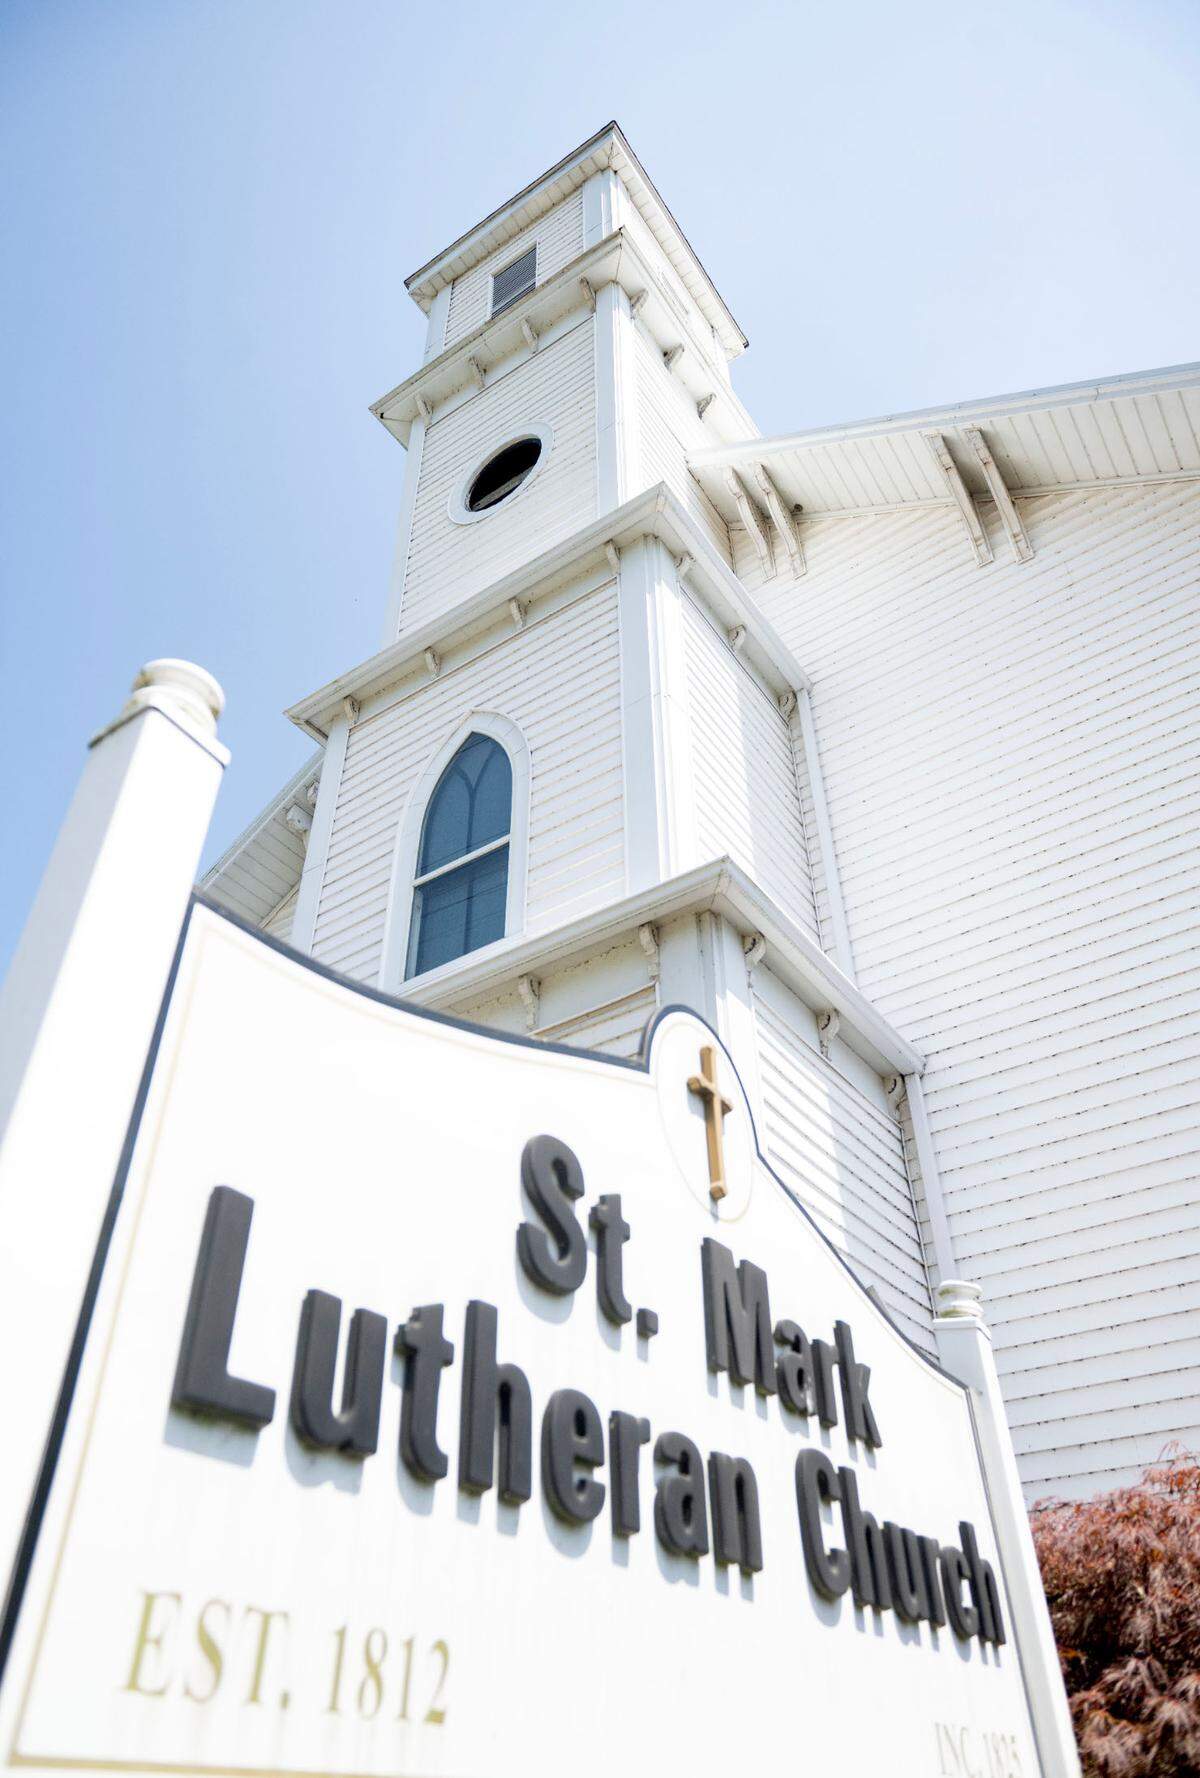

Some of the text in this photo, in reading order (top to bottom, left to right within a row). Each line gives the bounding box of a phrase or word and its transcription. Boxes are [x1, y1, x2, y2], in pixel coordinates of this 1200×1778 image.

[170, 1184, 1007, 1647] Lutheran Church
[516, 1134, 883, 1449] St. Mark
[124, 1588, 451, 1725] EST. 1812
